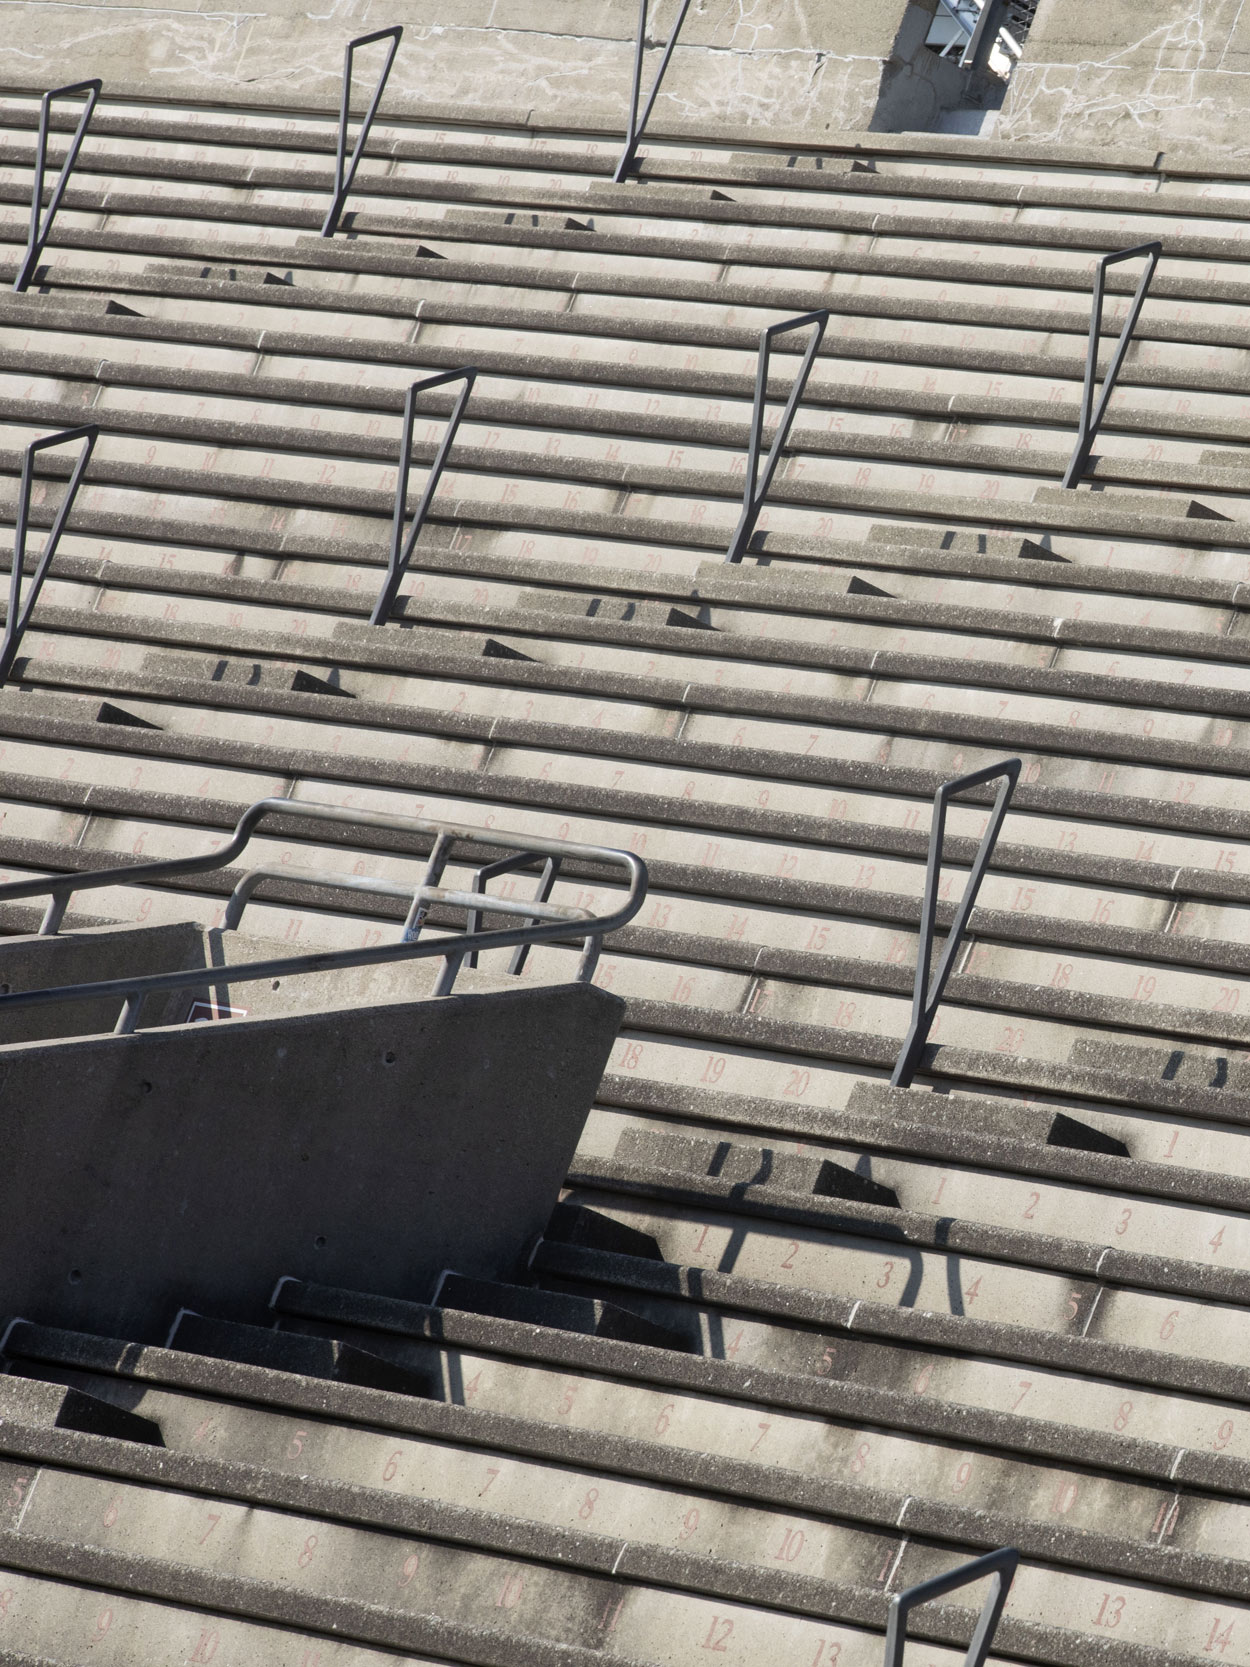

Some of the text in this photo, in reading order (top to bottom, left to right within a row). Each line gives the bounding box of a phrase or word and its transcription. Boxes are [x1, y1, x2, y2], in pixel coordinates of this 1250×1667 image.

[985, 380, 1004, 397] 15
[666, 450, 683, 466] 15
[317, 464, 335, 483] 12
[378, 472, 395, 490] 13
[501, 483, 518, 503] 15
[806, 734, 819, 754] 7
[1173, 781, 1196, 805] 12
[776, 854, 798, 878] 12
[136, 897, 153, 922] 9
[1011, 887, 1038, 910] 15
[648, 903, 672, 928] 13
[805, 924, 830, 950] 15
[1049, 962, 1073, 989] 18
[1131, 975, 1156, 1000] 19
[1212, 986, 1240, 1012] 20
[619, 1042, 644, 1070] 18
[700, 1056, 727, 1083] 19
[783, 1069, 811, 1097] 20
[1164, 1131, 1179, 1158] 1
[932, 1176, 947, 1205] 1
[1022, 1192, 1040, 1219] 2
[1115, 1207, 1133, 1236] 3
[693, 1224, 712, 1254] 1
[1209, 1228, 1225, 1253] 4
[876, 1261, 894, 1288] 3
[965, 1278, 982, 1304] 4
[1063, 1292, 1082, 1320] 5
[1159, 1308, 1181, 1341] 6
[727, 1331, 743, 1359] 4
[817, 1346, 837, 1376] 5
[465, 1372, 481, 1401] 4
[914, 1363, 935, 1396] 6
[558, 1386, 577, 1415] 5
[1012, 1380, 1032, 1409] 7
[654, 1402, 675, 1436] 6
[1113, 1401, 1134, 1432] 8
[288, 1429, 309, 1460] 5
[750, 1422, 771, 1452] 7
[1212, 1420, 1234, 1451] 9
[382, 1449, 403, 1482] 6
[851, 1442, 871, 1472] 8
[7, 1475, 29, 1507] 5
[480, 1467, 501, 1496] 7
[1050, 1479, 1079, 1513] 10
[102, 1496, 123, 1528] 6
[578, 1488, 599, 1520] 8
[1152, 1501, 1179, 1536] 11
[200, 1514, 221, 1544] 7
[680, 1508, 699, 1540] 9
[298, 1535, 318, 1568] 8
[773, 1528, 804, 1562] 10
[396, 1554, 419, 1588] 9
[496, 1574, 525, 1608] 10
[1093, 1593, 1126, 1627] 13
[91, 1608, 113, 1644] 9
[701, 1616, 734, 1653] 12
[1204, 1618, 1234, 1653] 14
[188, 1626, 220, 1664] 10
